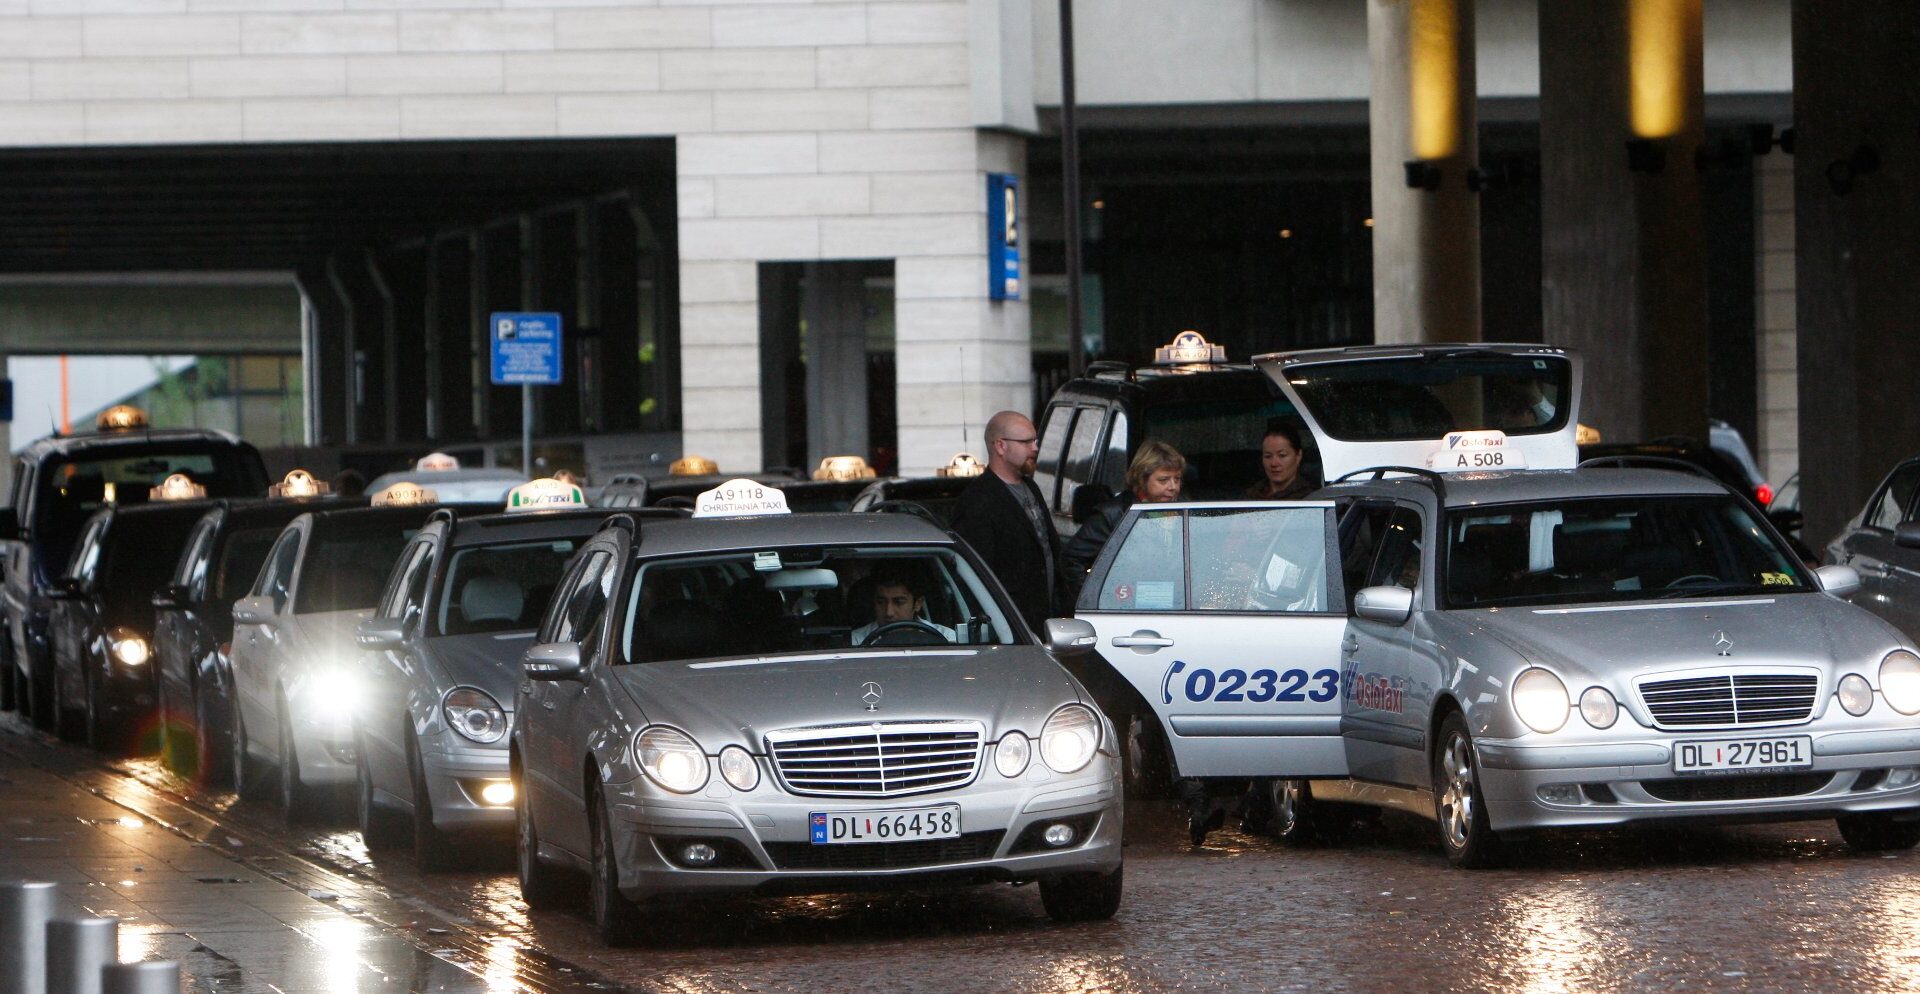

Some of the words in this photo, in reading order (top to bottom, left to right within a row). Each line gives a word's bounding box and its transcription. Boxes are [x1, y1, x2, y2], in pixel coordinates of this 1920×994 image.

[498, 319, 514, 340] P
[1457, 454, 1468, 467] A
[1474, 452, 1504, 467] 508
[702, 503, 759, 513] CHRISTIANIA
[761, 501, 782, 509] TAXI
[1119, 588, 1128, 599] 5
[1184, 668, 1340, 703] 02323
[1356, 673, 1403, 715] OsloTaxi
[1682, 744, 1713, 768] DL
[1728, 740, 1803, 766] 27961
[816, 831, 824, 839] N
[832, 817, 863, 839] DL
[877, 811, 953, 838] 66458
